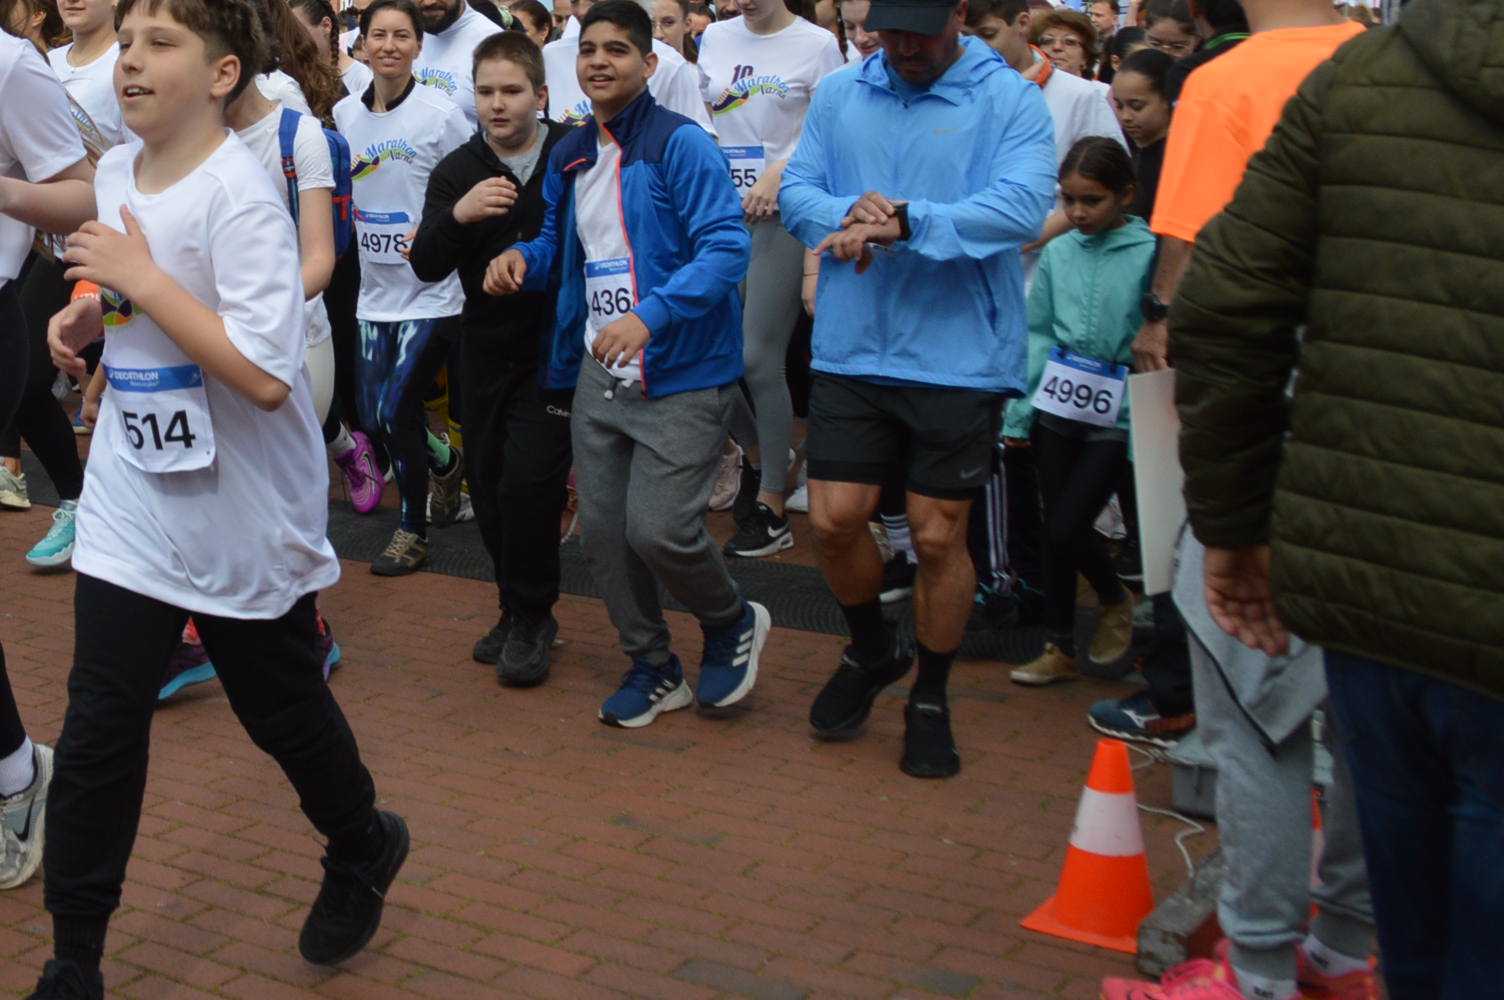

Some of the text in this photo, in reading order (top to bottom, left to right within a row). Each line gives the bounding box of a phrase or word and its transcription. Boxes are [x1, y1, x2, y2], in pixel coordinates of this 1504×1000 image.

[730, 64, 754, 86] 10
[365, 138, 417, 161] Marathon
[361, 232, 408, 254] 4978
[592, 287, 635, 317] 436
[1043, 376, 1113, 415] 4996
